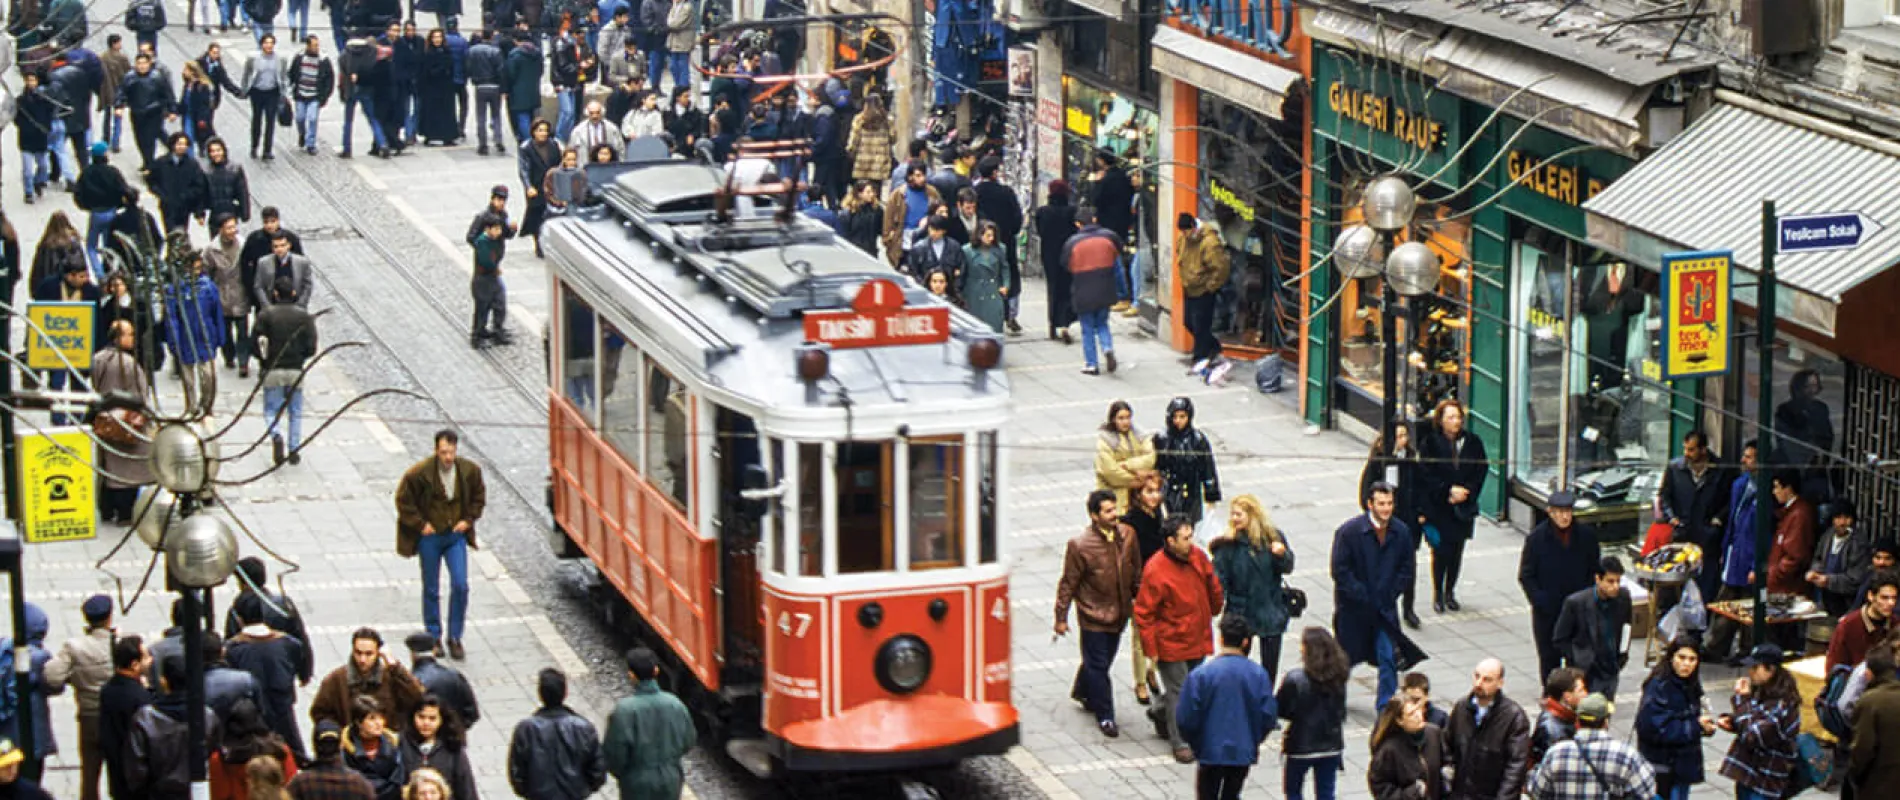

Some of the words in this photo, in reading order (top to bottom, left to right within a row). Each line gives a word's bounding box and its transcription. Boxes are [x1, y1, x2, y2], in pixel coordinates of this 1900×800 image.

[1829, 223, 1857, 238] Sokak
[44, 311, 79, 331] tex
[1678, 330, 1701, 342] tex
[1678, 340, 1709, 352] mex
[777, 610, 813, 639] 47
